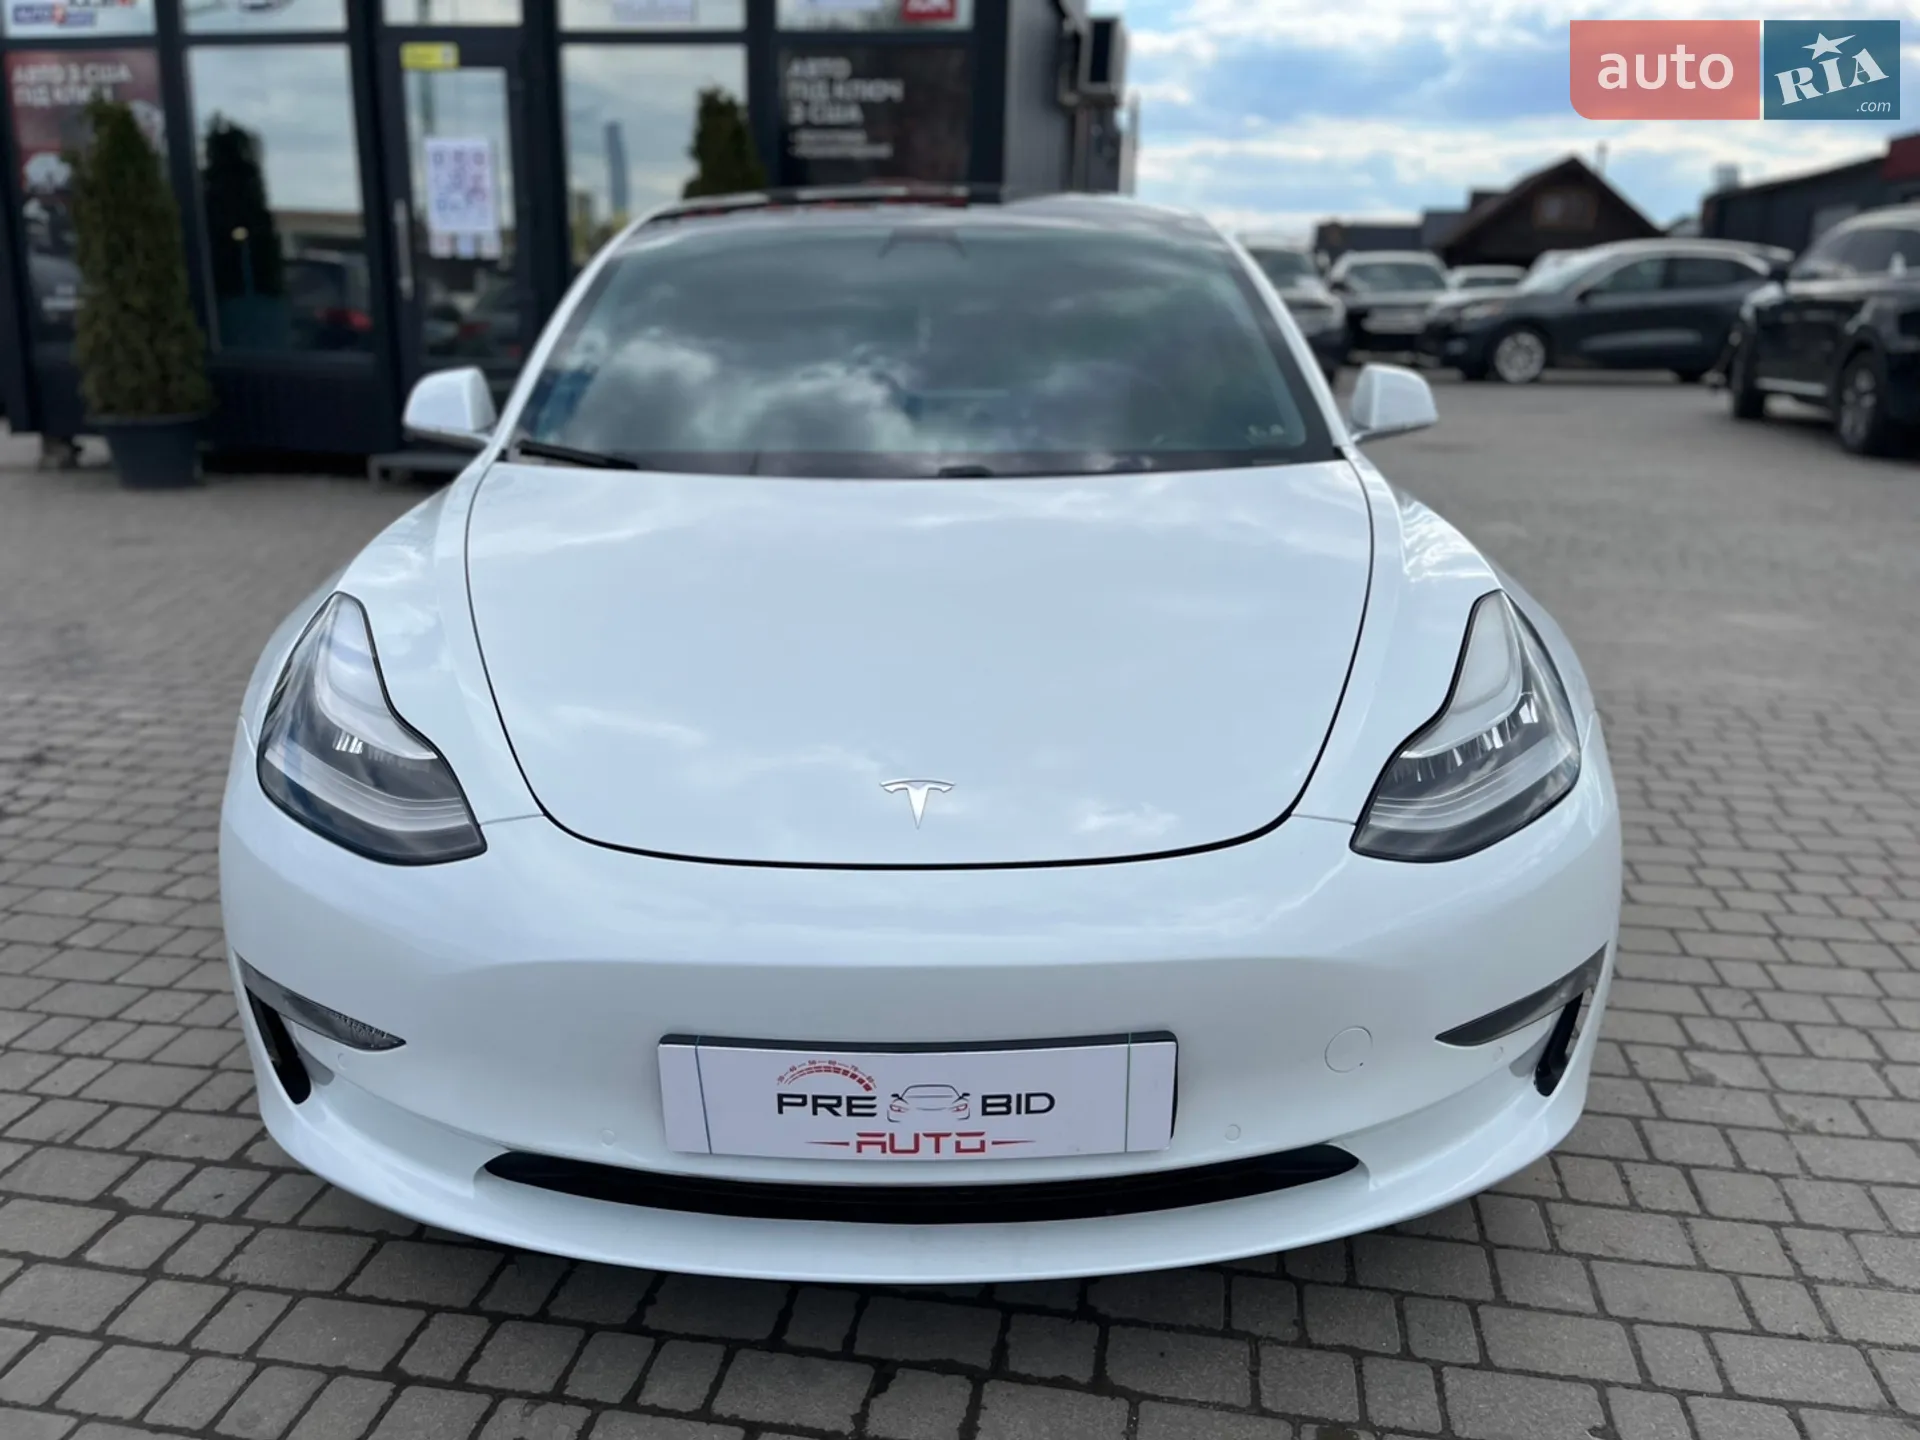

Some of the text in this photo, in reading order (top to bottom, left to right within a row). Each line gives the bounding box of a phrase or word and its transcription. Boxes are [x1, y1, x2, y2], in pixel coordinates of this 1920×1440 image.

[777, 1092, 1055, 1117] PRE BID
[856, 1131, 986, 1154] AUTO
